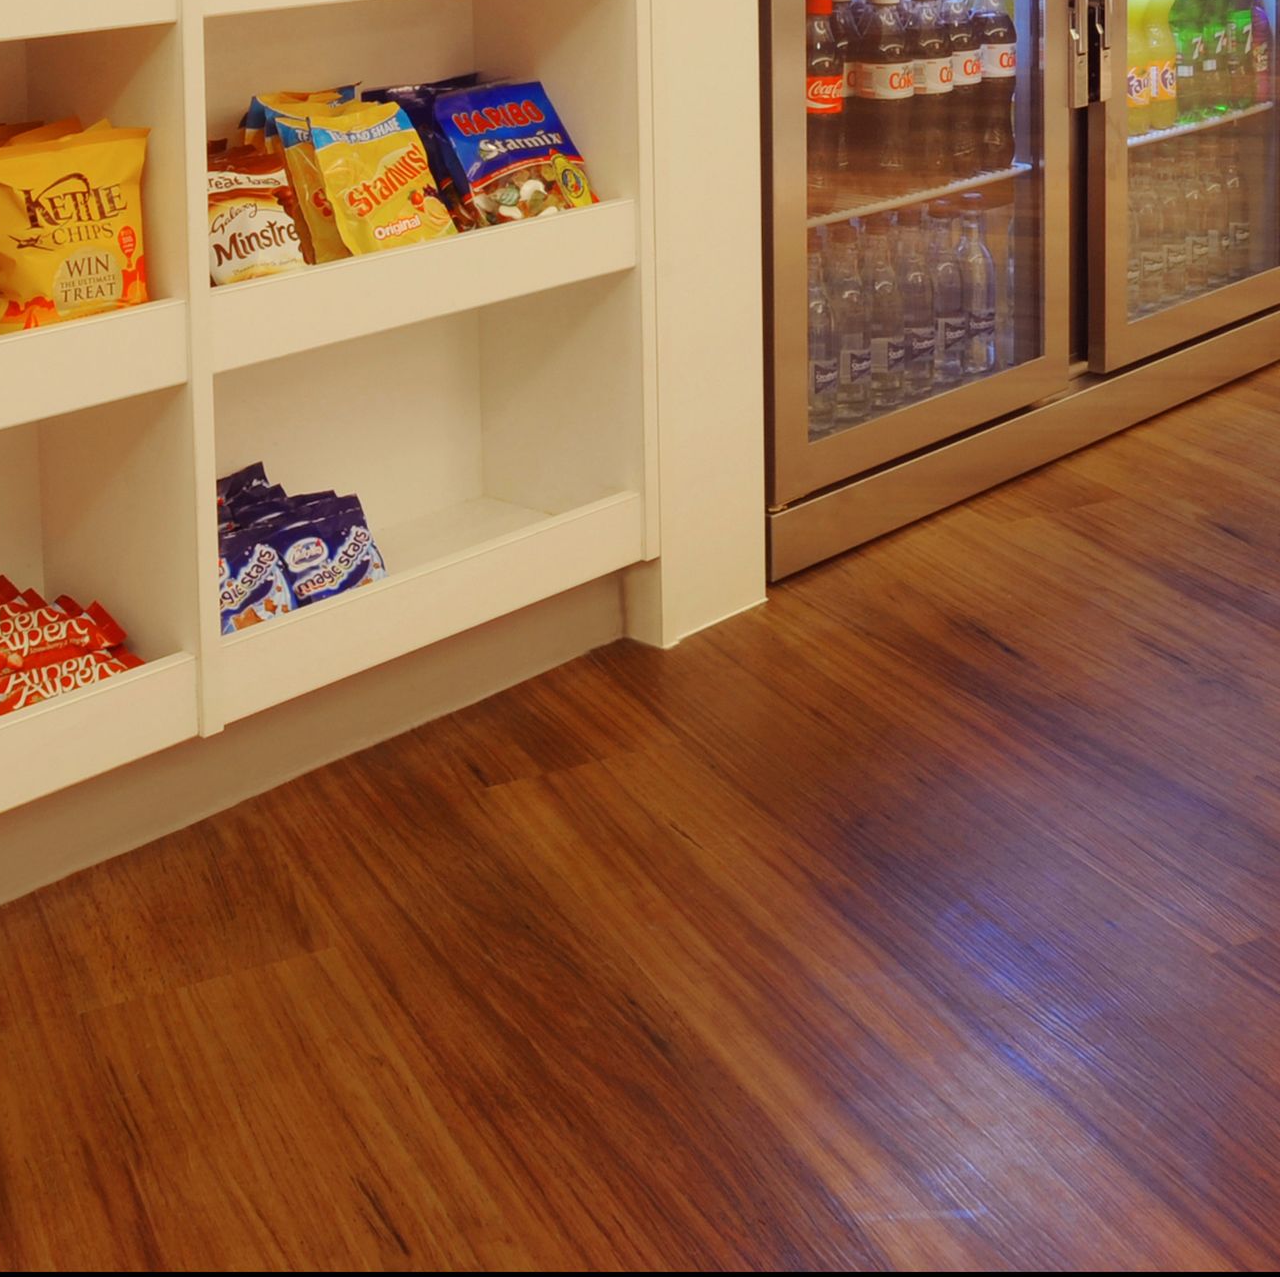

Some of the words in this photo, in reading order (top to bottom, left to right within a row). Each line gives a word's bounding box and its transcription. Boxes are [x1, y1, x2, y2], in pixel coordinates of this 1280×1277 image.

[451, 99, 546, 137] HARIBO
[20, 172, 128, 230] KETTLE
[207, 176, 244, 190] reat
[51, 222, 114, 246] CHIPS
[208, 202, 259, 236] Galaxy
[373, 215, 421, 240] Original
[213, 220, 300, 267] Minstre
[60, 280, 76, 290] THE
[77, 274, 117, 287] ULTIMATE
[65, 254, 110, 278] WIN
[60, 282, 117, 303] TREAT
[241, 549, 277, 588] stars
[295, 564, 343, 597] magic
[338, 529, 370, 568] stars
[4, 654, 97, 695] Alpen
[13, 661, 121, 710] Alpen
